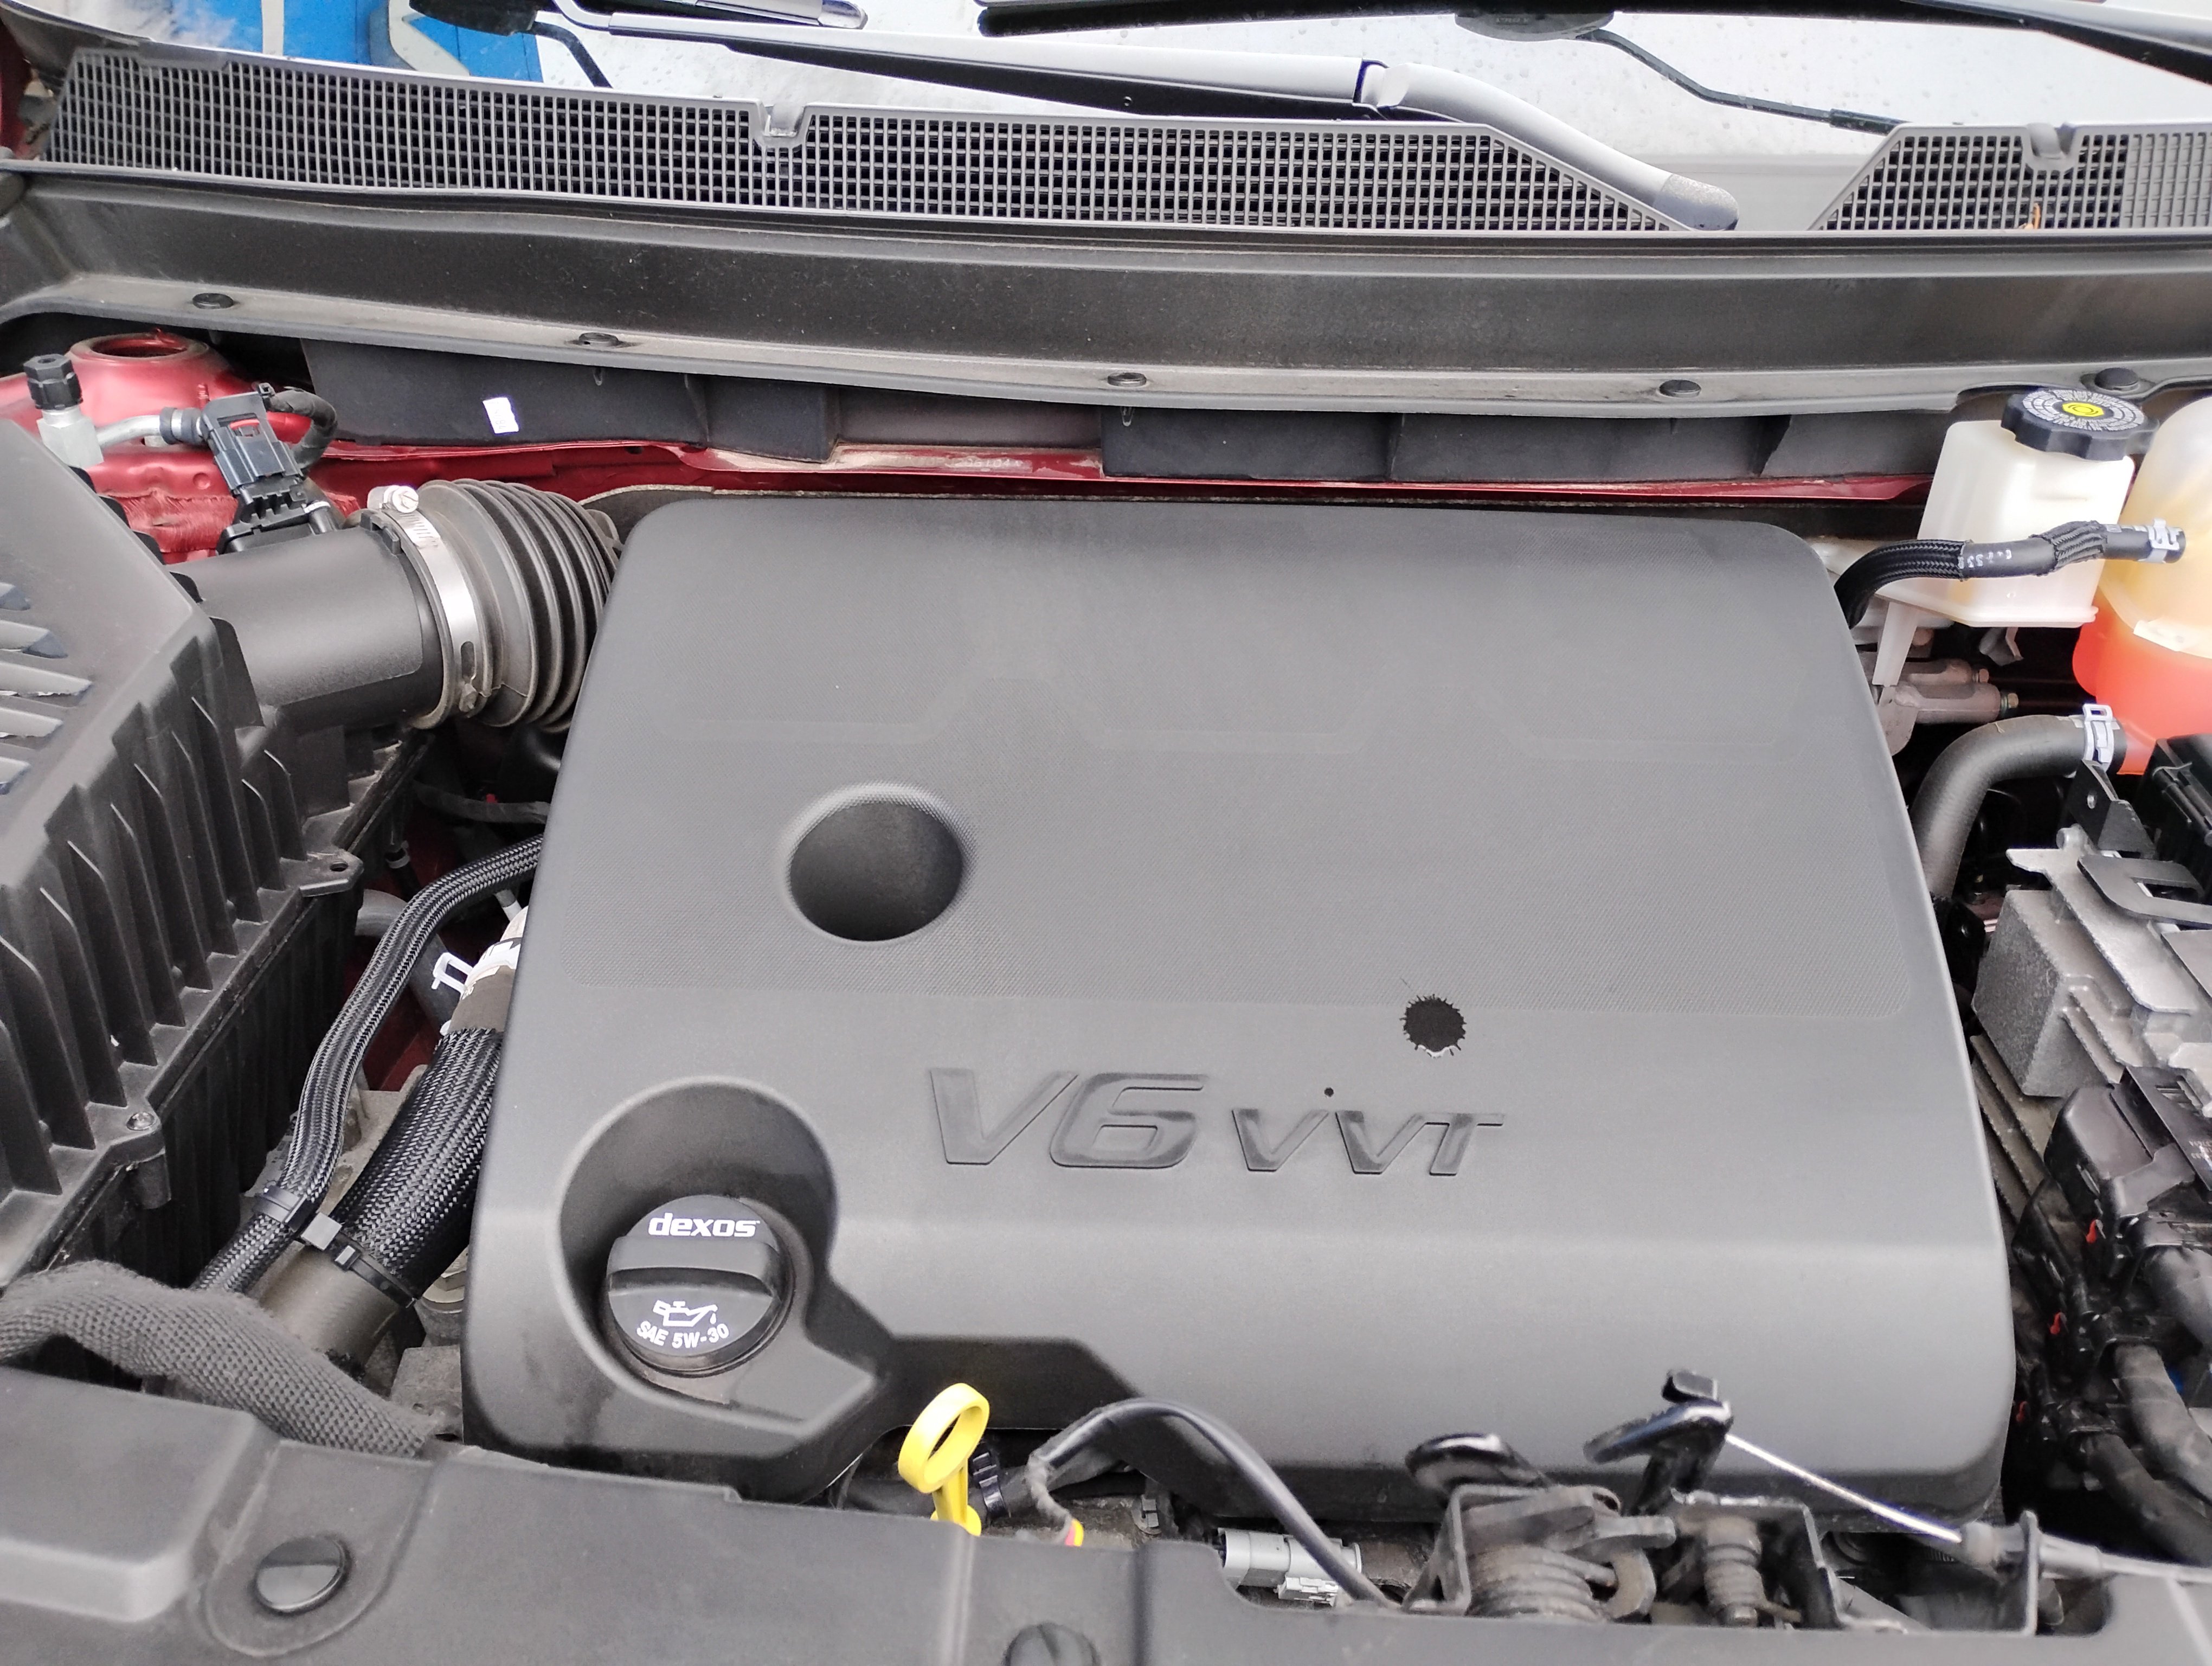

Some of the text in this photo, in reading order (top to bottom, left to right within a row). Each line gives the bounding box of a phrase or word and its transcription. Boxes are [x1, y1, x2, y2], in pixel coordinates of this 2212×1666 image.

[929, 1067, 1504, 1176] V6 VVT
[648, 1212, 757, 1238] dexos
[636, 1321, 730, 1349] SAE 5W-30
